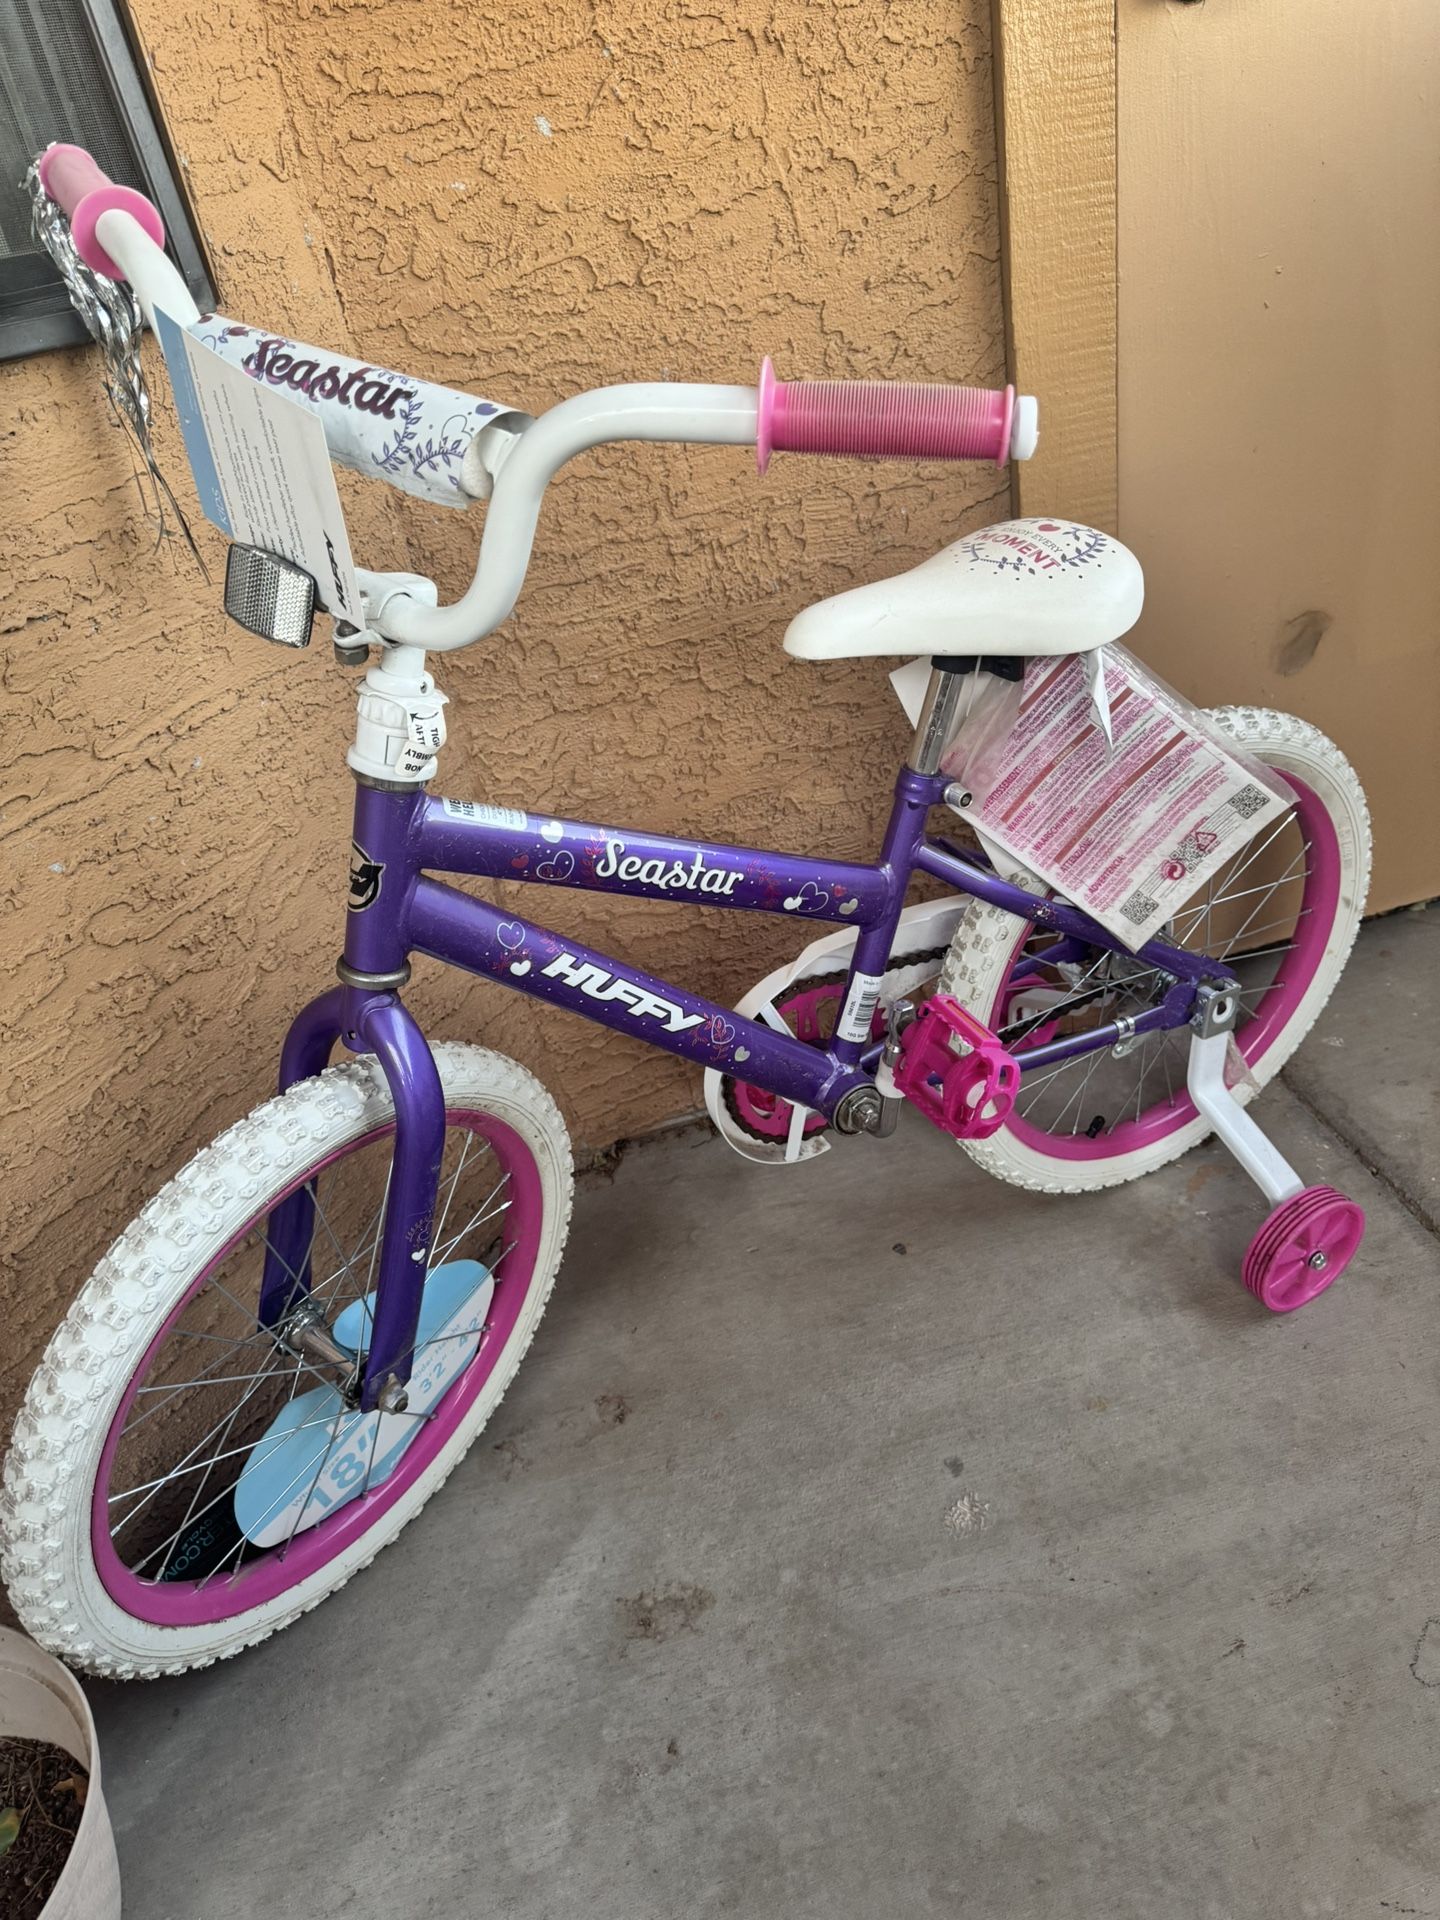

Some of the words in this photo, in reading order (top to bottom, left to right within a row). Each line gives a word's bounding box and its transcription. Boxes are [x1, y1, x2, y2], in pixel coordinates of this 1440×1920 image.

[242, 339, 414, 420] Seastar
[974, 533, 1061, 569] MOMENT
[1031, 533, 1063, 553] EVERY
[322, 528, 347, 612] HUFFY
[1007, 801, 1037, 833] WARNUNG:
[1031, 804, 1078, 853] WAARSCHUWING:
[595, 839, 744, 895] Seastar
[1087, 852, 1126, 894] ADVERTENCIA:
[540, 951, 706, 1032] HUFFY
